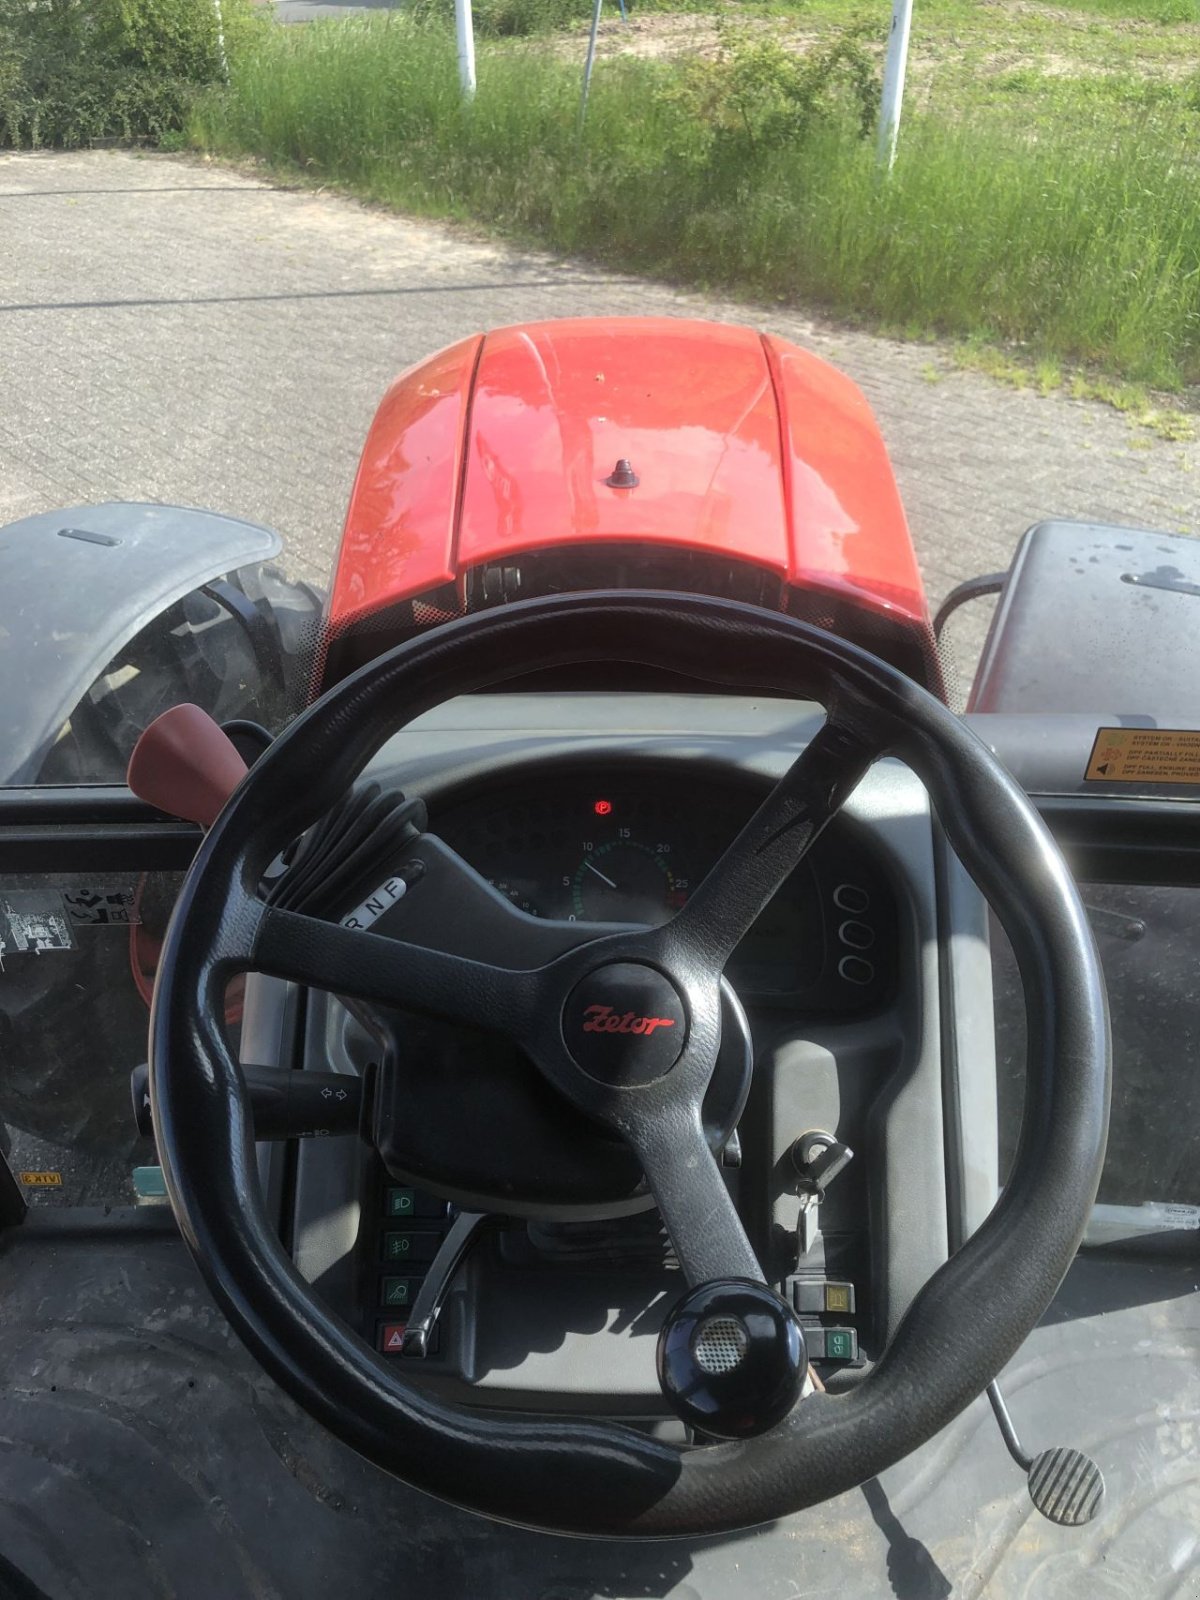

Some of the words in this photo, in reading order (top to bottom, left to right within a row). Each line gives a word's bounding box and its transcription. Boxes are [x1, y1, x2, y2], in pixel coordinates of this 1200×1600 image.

[619, 828, 632, 839] 15
[582, 841, 594, 852] 10
[656, 842, 671, 853] 20
[562, 876, 570, 887] 5
[675, 879, 689, 888] 25
[365, 897, 385, 916] N
[384, 880, 399, 899] F
[583, 1004, 675, 1036] Zetor
